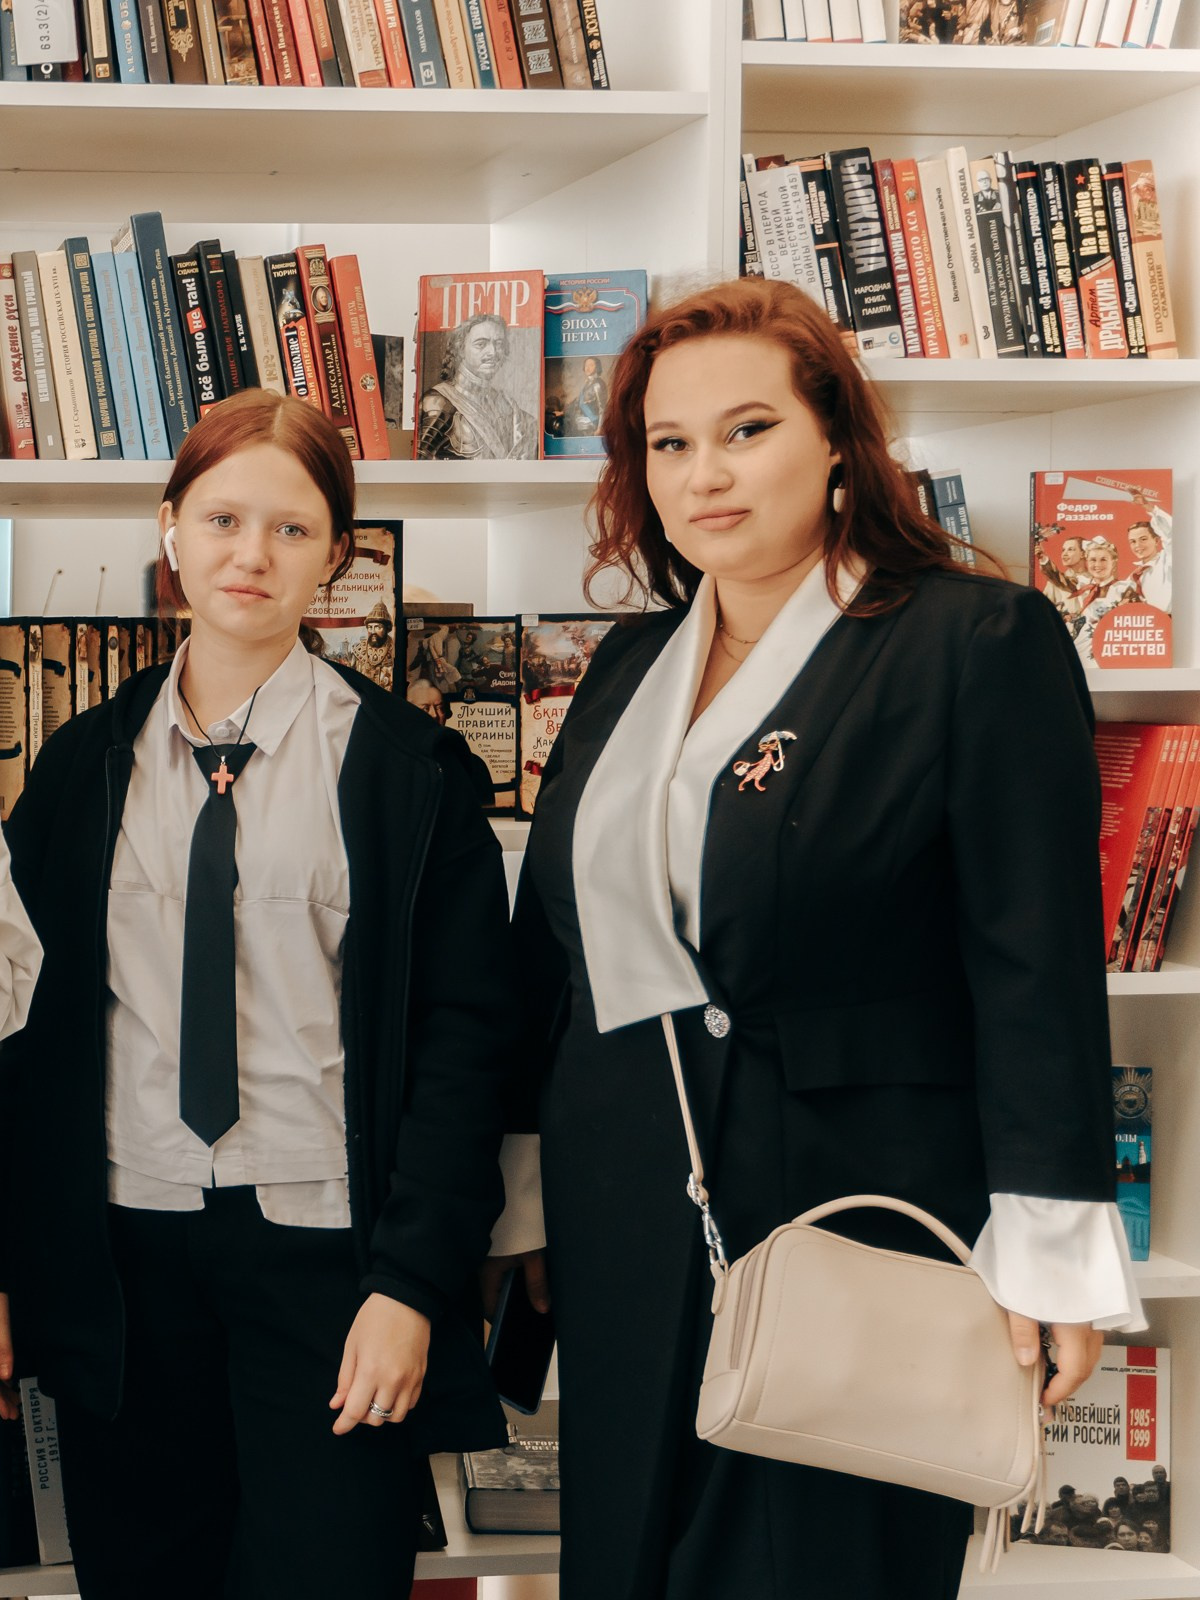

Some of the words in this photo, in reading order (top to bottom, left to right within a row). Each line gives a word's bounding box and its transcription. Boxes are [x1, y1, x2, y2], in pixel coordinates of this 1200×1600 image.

[415, 10, 427, 52] МИХАЙЛОВ
[466, 0, 483, 28] ГЕНЕРА
[272, 16, 286, 52] Пожарские
[471, 32, 490, 71] РУССКИЕ
[958, 167, 969, 204] ПОБЕДА
[1088, 167, 1103, 206] войне
[757, 191, 773, 234] ПЕРИОД
[791, 173, 809, 242] (1941-1945)
[808, 181, 824, 235] СТАЛИНСКИХ
[840, 156, 887, 274] БЛОКАДА
[907, 210, 919, 232] АСА
[964, 208, 975, 239] НАРОД
[1025, 187, 1041, 236] ГРОМКИЕ»
[1076, 191, 1095, 232] войне
[771, 208, 787, 256] ВЕЛИКОЙ
[778, 185, 803, 275] ОТЕЧЕСТВЕННОЙ
[940, 211, 954, 269] Отечественная
[1051, 221, 1066, 240] АД»
[1079, 237, 1097, 257] На
[1097, 232, 1110, 253] как
[768, 250, 780, 277] СССР
[802, 246, 816, 284] ВОЙНЫ
[891, 232, 907, 270] АРМИЯ
[970, 243, 980, 274] ВОЙНА
[1032, 238, 1045, 268] ЗДЕСЬ
[1054, 242, 1069, 266] АДОВ
[1117, 232, 1132, 280] ОШИБАЕТСЯ
[22, 270, 37, 305] ГРОЗНЫЙ
[854, 282, 891, 295] НАРОДНАЯ
[911, 236, 931, 306] ТАНКОВОГО
[949, 271, 959, 303] Великая
[1057, 268, 1072, 287] «ИЗ
[158, 271, 171, 317] Куликовская
[182, 277, 198, 309] так!
[215, 279, 231, 333] НАПОЛЕОНА
[440, 280, 530, 329] ПЕТР
[864, 294, 886, 304] КНИГА
[1146, 251, 1162, 333] ПРОХОРОВСКОЕ
[1156, 263, 1168, 318] СРАЖЕНИЕ
[191, 312, 203, 329] не
[562, 318, 607, 330] ЭПОХА
[862, 305, 892, 316] ПАМЯТИ
[899, 286, 920, 354] ПАРТИЗАНЫ
[1060, 302, 1084, 350] ДРАБКИН
[1096, 278, 1125, 350] ДРАБКИН
[30, 330, 45, 366] ГОСУДАРЬ
[563, 331, 601, 342] ПЕТРА
[923, 310, 938, 355] ПРАВДА
[158, 332, 171, 379] благоверный
[196, 333, 210, 372] было
[224, 336, 239, 388] НАШЕСТВИЕ
[265, 353, 279, 382] 1812
[289, 340, 306, 388] Николае
[299, 324, 313, 380] ИМПЕРАТОР
[35, 369, 49, 403] ВЕЛИКИЙ
[165, 381, 175, 407] Святой
[200, 377, 215, 402] Всё
[323, 349, 341, 408] АЛЕКСАНДР
[1056, 512, 1114, 522] Раззаков
[1057, 503, 1098, 513] Федор
[1104, 630, 1164, 642] ЛУЧШЕЕ
[1113, 615, 1154, 628] НАШЕ
[1101, 644, 1166, 657] ДЕТСТВО
[457, 719, 516, 728] ПРАВИТЕЛ
[28, 1387, 42, 1433] ОКТЯБРЯ
[1061, 1403, 1120, 1425] НОВЕЙШЕЙ
[1130, 1408, 1155, 1427] 1985-
[1074, 1426, 1120, 1446] РОССИИ
[1129, 1429, 1150, 1447] 1999
[37, 1447, 50, 1490] РОССИЯ
